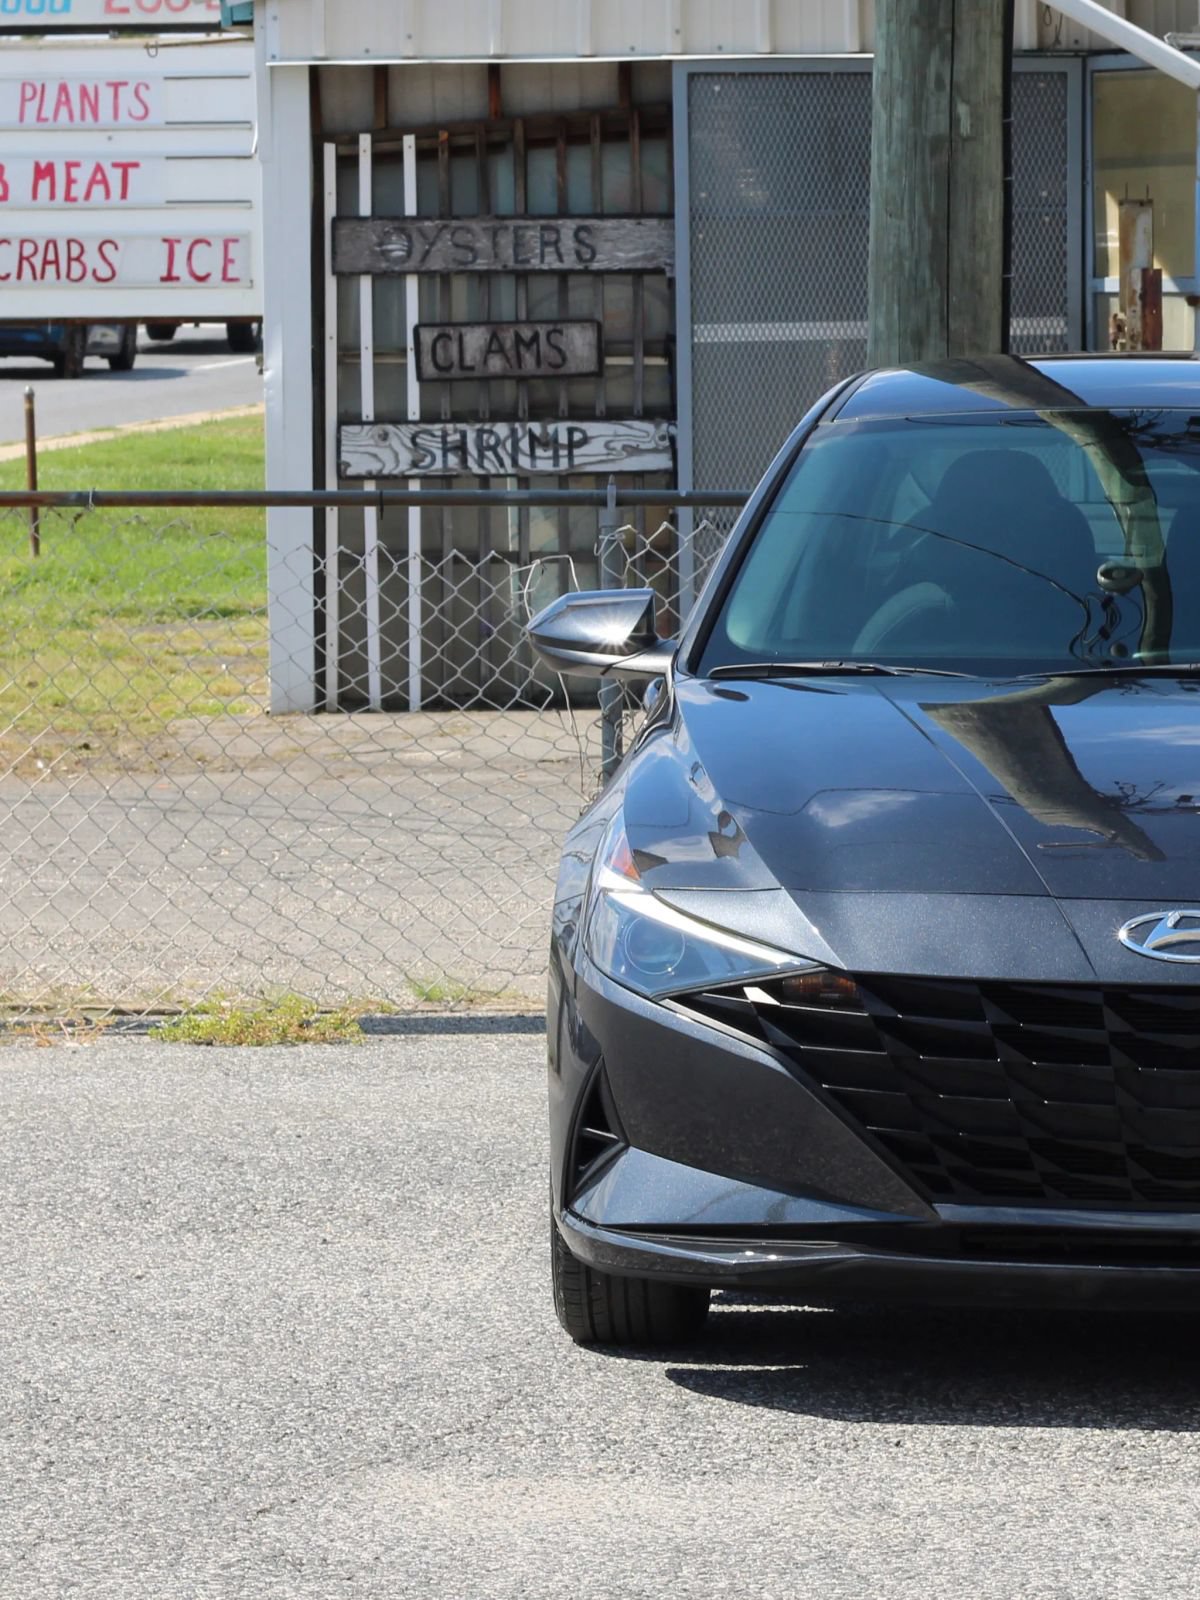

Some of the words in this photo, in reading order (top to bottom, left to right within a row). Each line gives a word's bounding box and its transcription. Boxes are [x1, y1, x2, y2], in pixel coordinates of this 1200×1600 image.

[19, 80, 151, 123] PLANTS
[31, 160, 141, 203] MEAT
[159, 238, 241, 283] ICE
[376, 223, 597, 265] OYSTERS
[430, 328, 569, 373] CLAMS
[410, 425, 589, 470] SHRIMP
